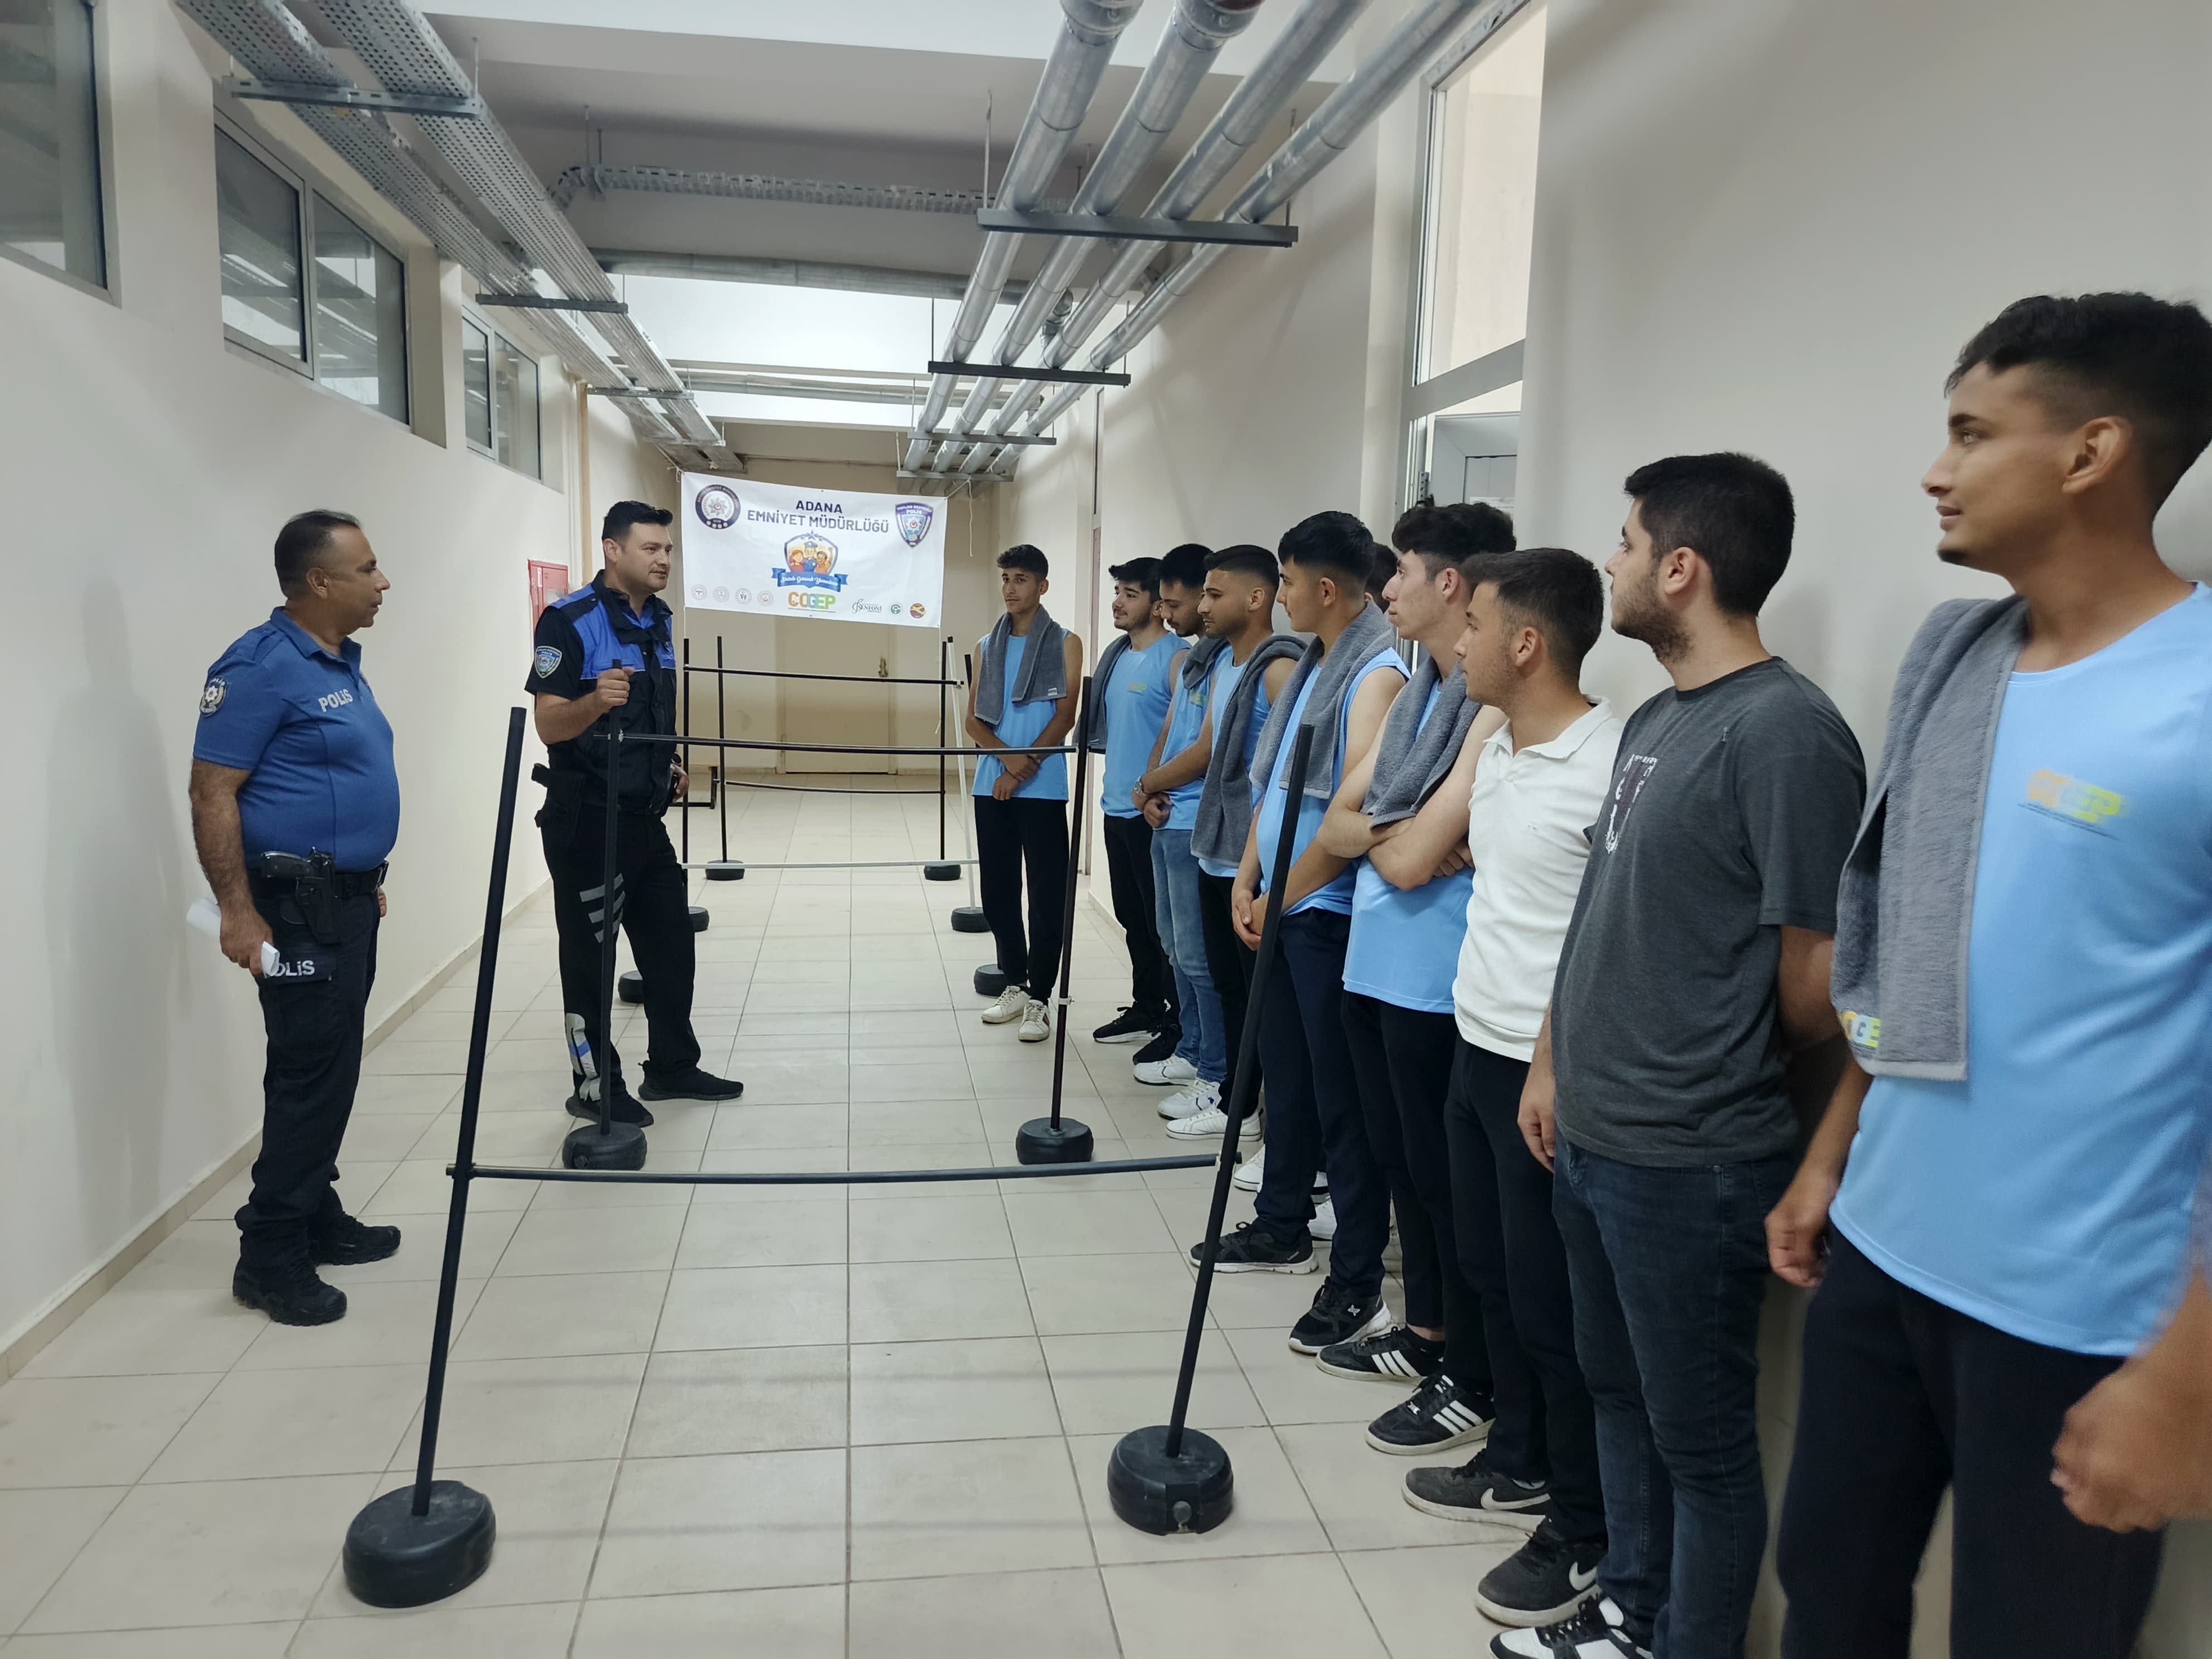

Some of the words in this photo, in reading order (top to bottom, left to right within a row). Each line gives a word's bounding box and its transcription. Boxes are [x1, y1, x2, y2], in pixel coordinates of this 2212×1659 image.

[795, 501, 843, 513] ADANA
[747, 510, 806, 526] EMNİYET
[809, 514, 890, 533] MÜDÜRLÜĞÜ
